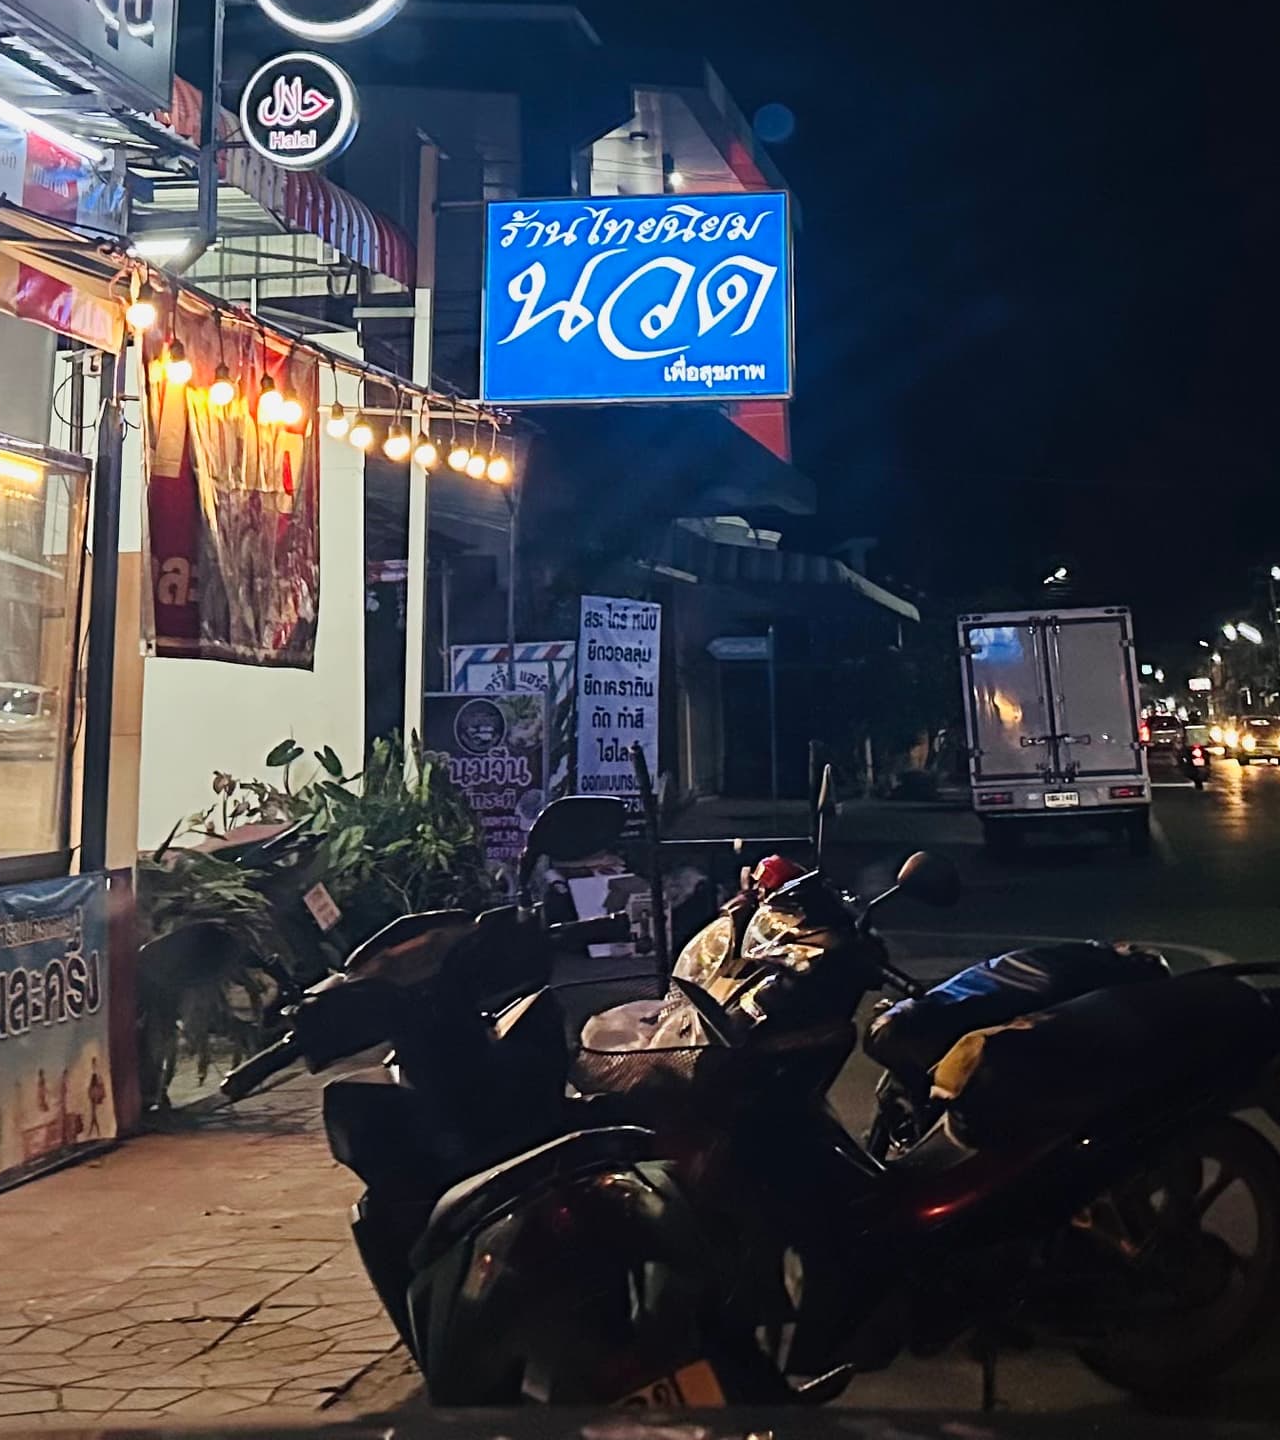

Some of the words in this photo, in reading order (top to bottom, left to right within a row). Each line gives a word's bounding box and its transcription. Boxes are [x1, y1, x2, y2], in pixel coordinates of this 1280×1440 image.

[257, 74, 334, 127] حلال
[268, 129, 317, 151] Halal
[499, 203, 774, 250] ร้านไทยนิยม
[497, 248, 778, 360] นวด
[663, 353, 766, 388] เพื่อสุขภาพ
[584, 610, 603, 628] สระ
[632, 607, 657, 631] หนีบ
[592, 706, 611, 729] ดัด
[618, 706, 645, 729] ทำสี
[423, 747, 532, 787] นมจีน
